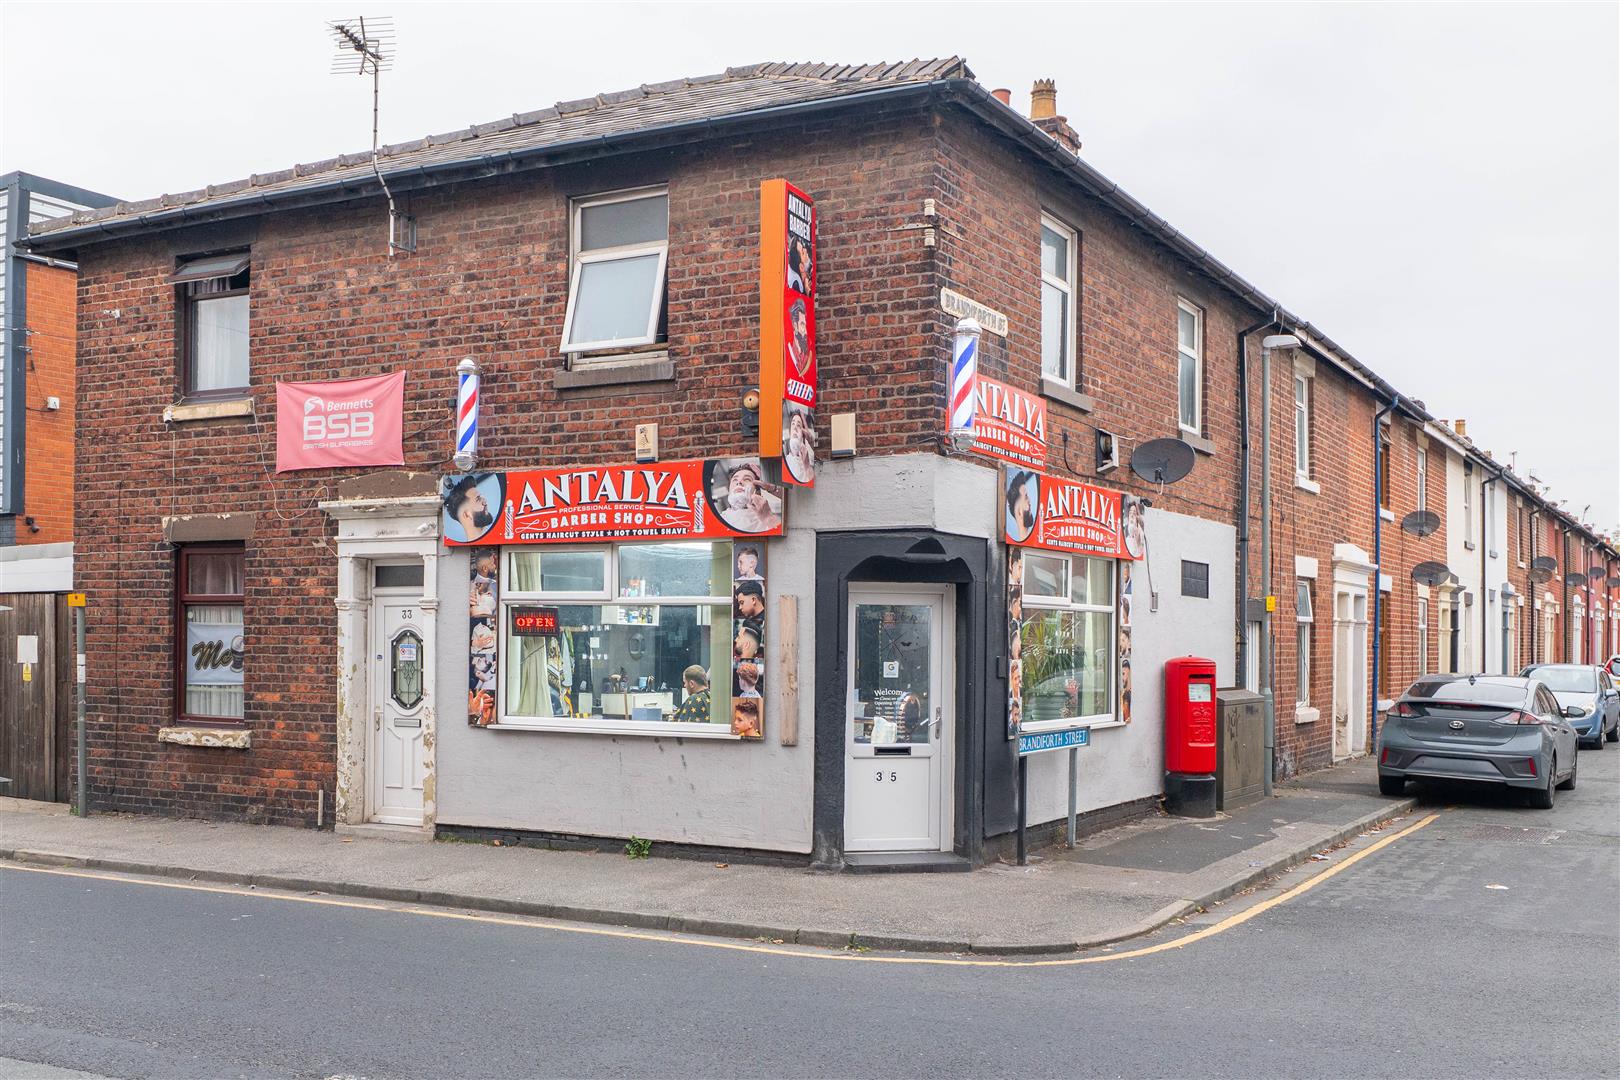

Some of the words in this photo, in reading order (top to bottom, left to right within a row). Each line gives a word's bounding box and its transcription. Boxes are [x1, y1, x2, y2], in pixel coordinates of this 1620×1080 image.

[788, 193, 812, 223] ANTALYA
[789, 214, 811, 242] BARBER
[327, 399, 374, 412] Bennetts
[975, 381, 1045, 443] NTALYA
[303, 411, 374, 441] BSB
[1009, 433, 1030, 452] SHOP
[517, 470, 690, 515] ANTALYA
[559, 504, 613, 514] PROFESSIONAL
[1044, 485, 1116, 531] ANTALYA
[550, 512, 608, 529] BARBER
[613, 512, 654, 526] SHOP
[546, 531, 580, 539] HAIRCUT
[581, 530, 605, 538] STYLE
[614, 529, 630, 537] HOT
[632, 528, 659, 536] TOWEL
[1060, 525, 1086, 538] BARBER
[1087, 528, 1105, 543] SHOP
[401, 610, 413, 619] 33
[516, 617, 555, 628] OPEN
[1019, 733, 1063, 751] BRANDIFORTH
[1064, 730, 1087, 745] STREET
